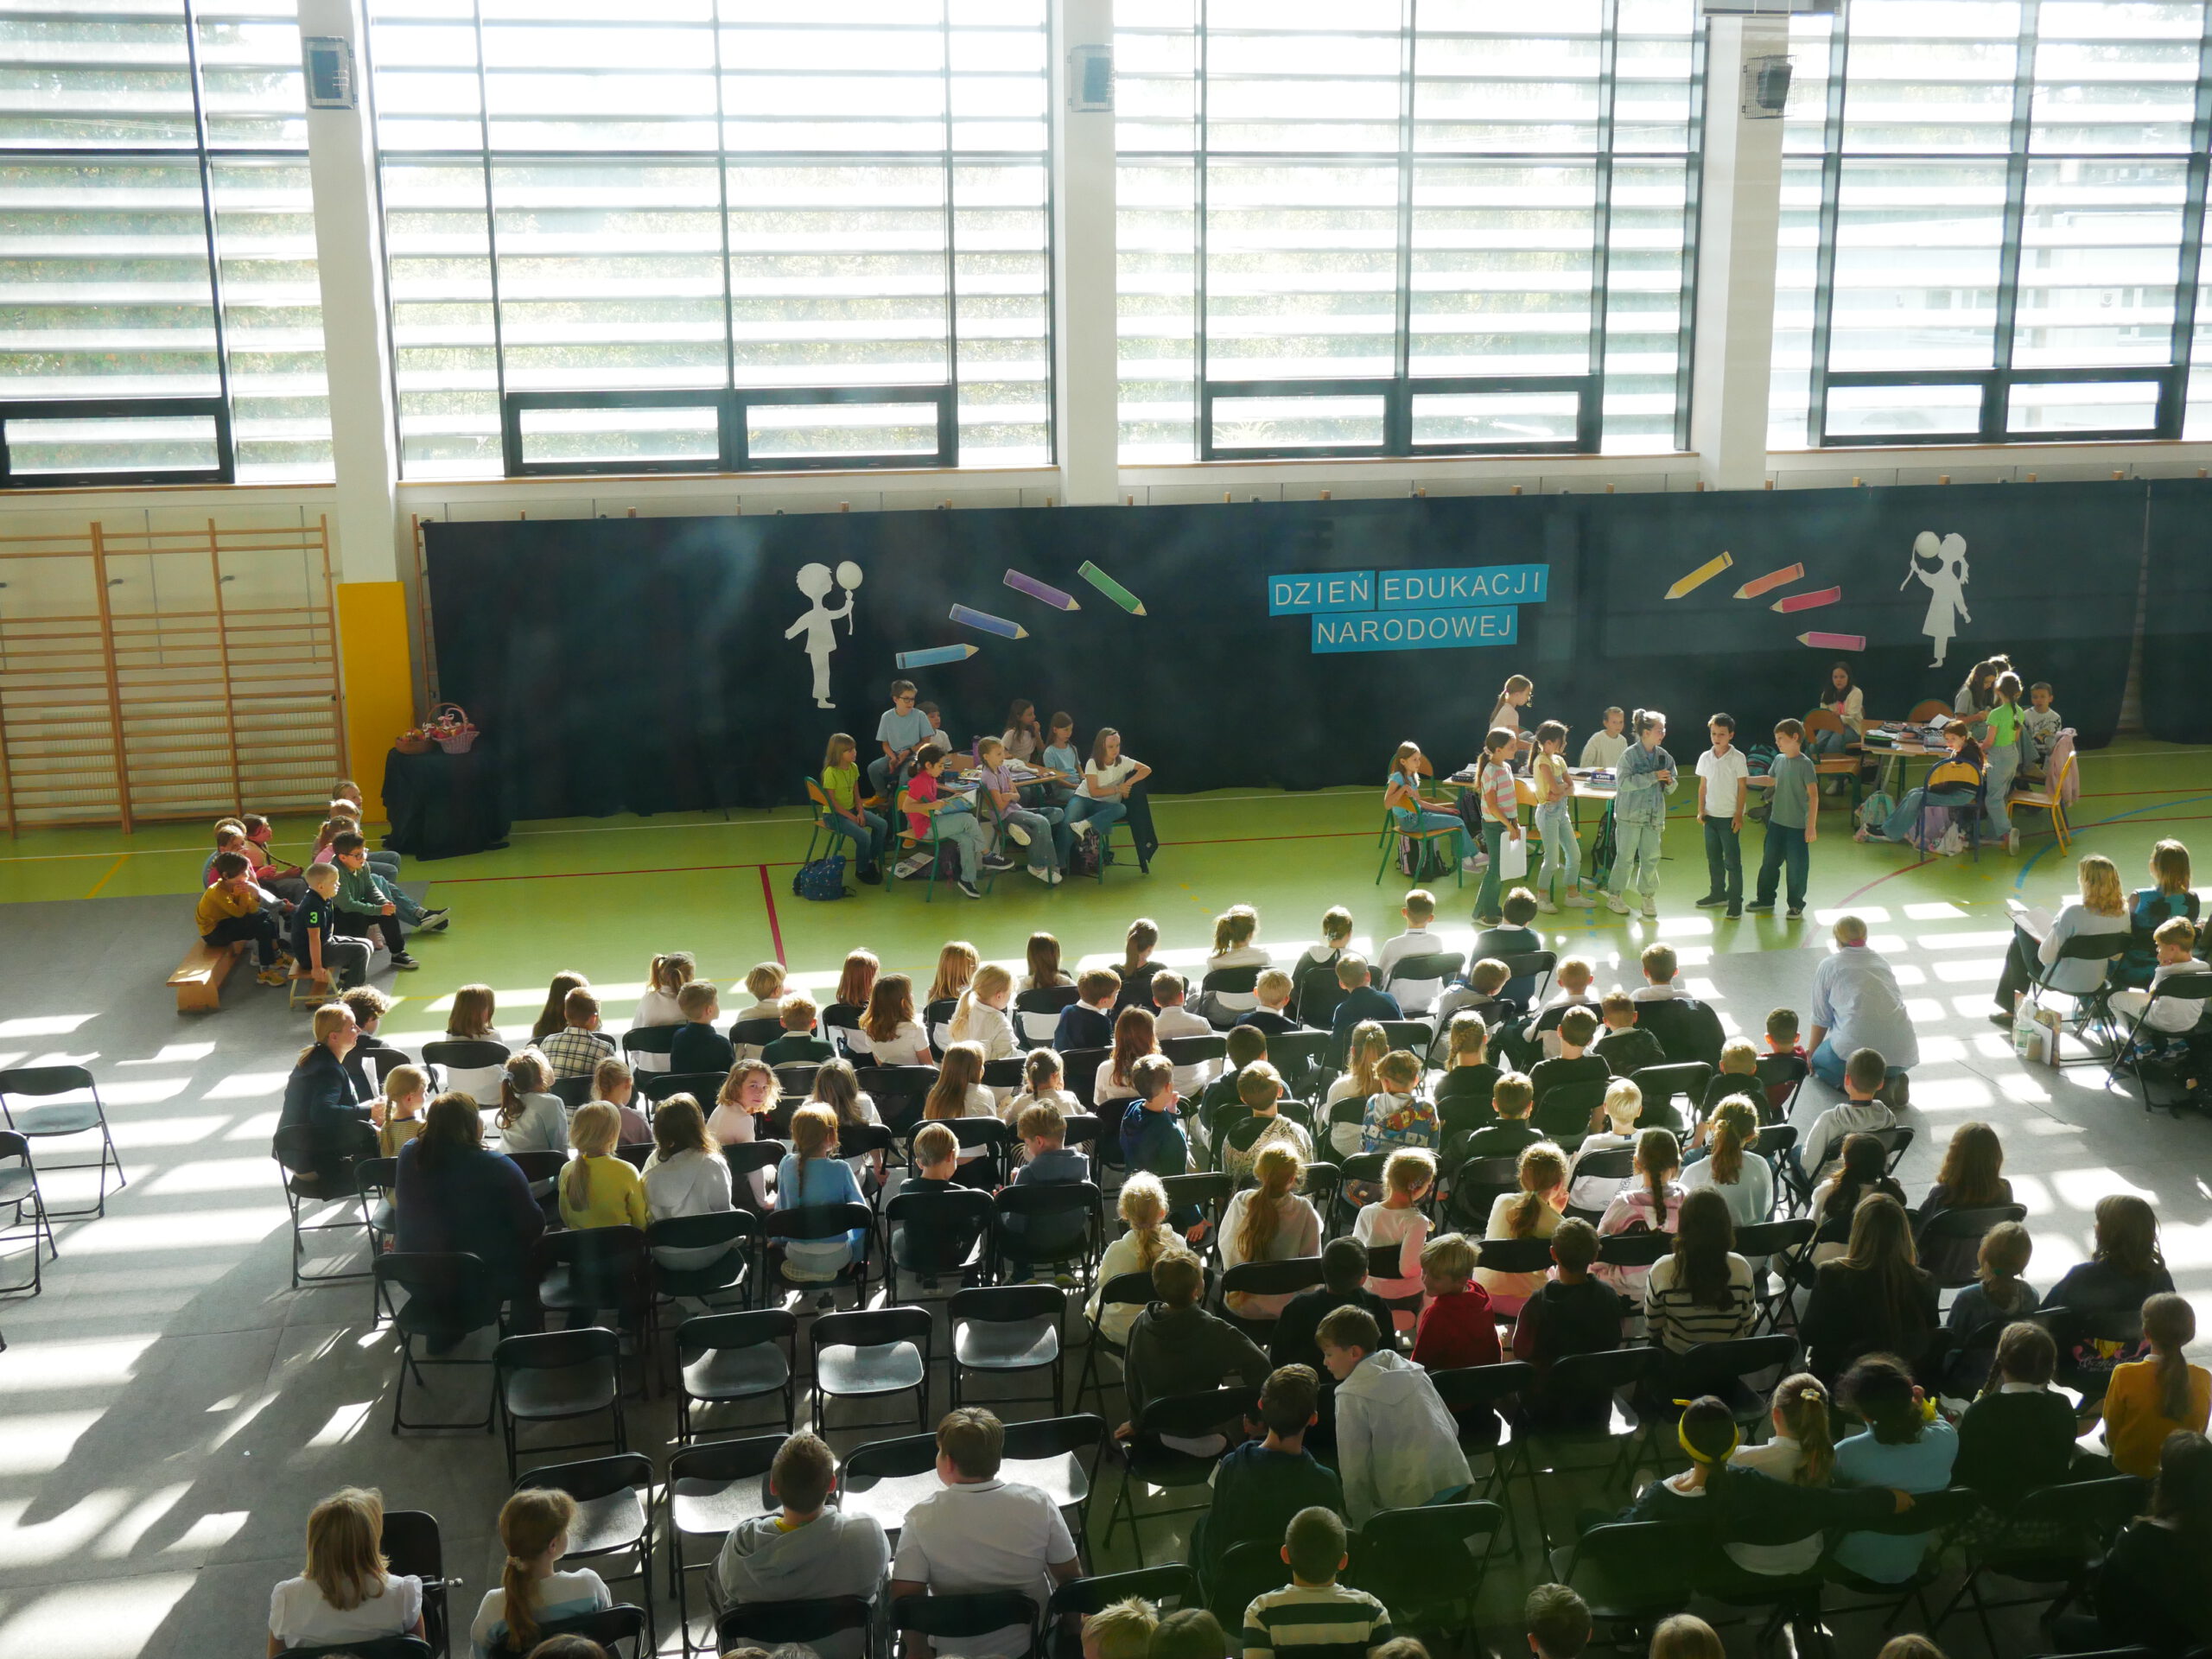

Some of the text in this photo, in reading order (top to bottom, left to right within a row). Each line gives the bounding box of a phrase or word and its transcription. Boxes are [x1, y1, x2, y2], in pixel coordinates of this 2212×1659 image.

[1274, 571, 1540, 606] DZIEŃ EDUKACJI
[1317, 614, 1511, 644] NARODOWEJ
[309, 912, 318, 924] 3
